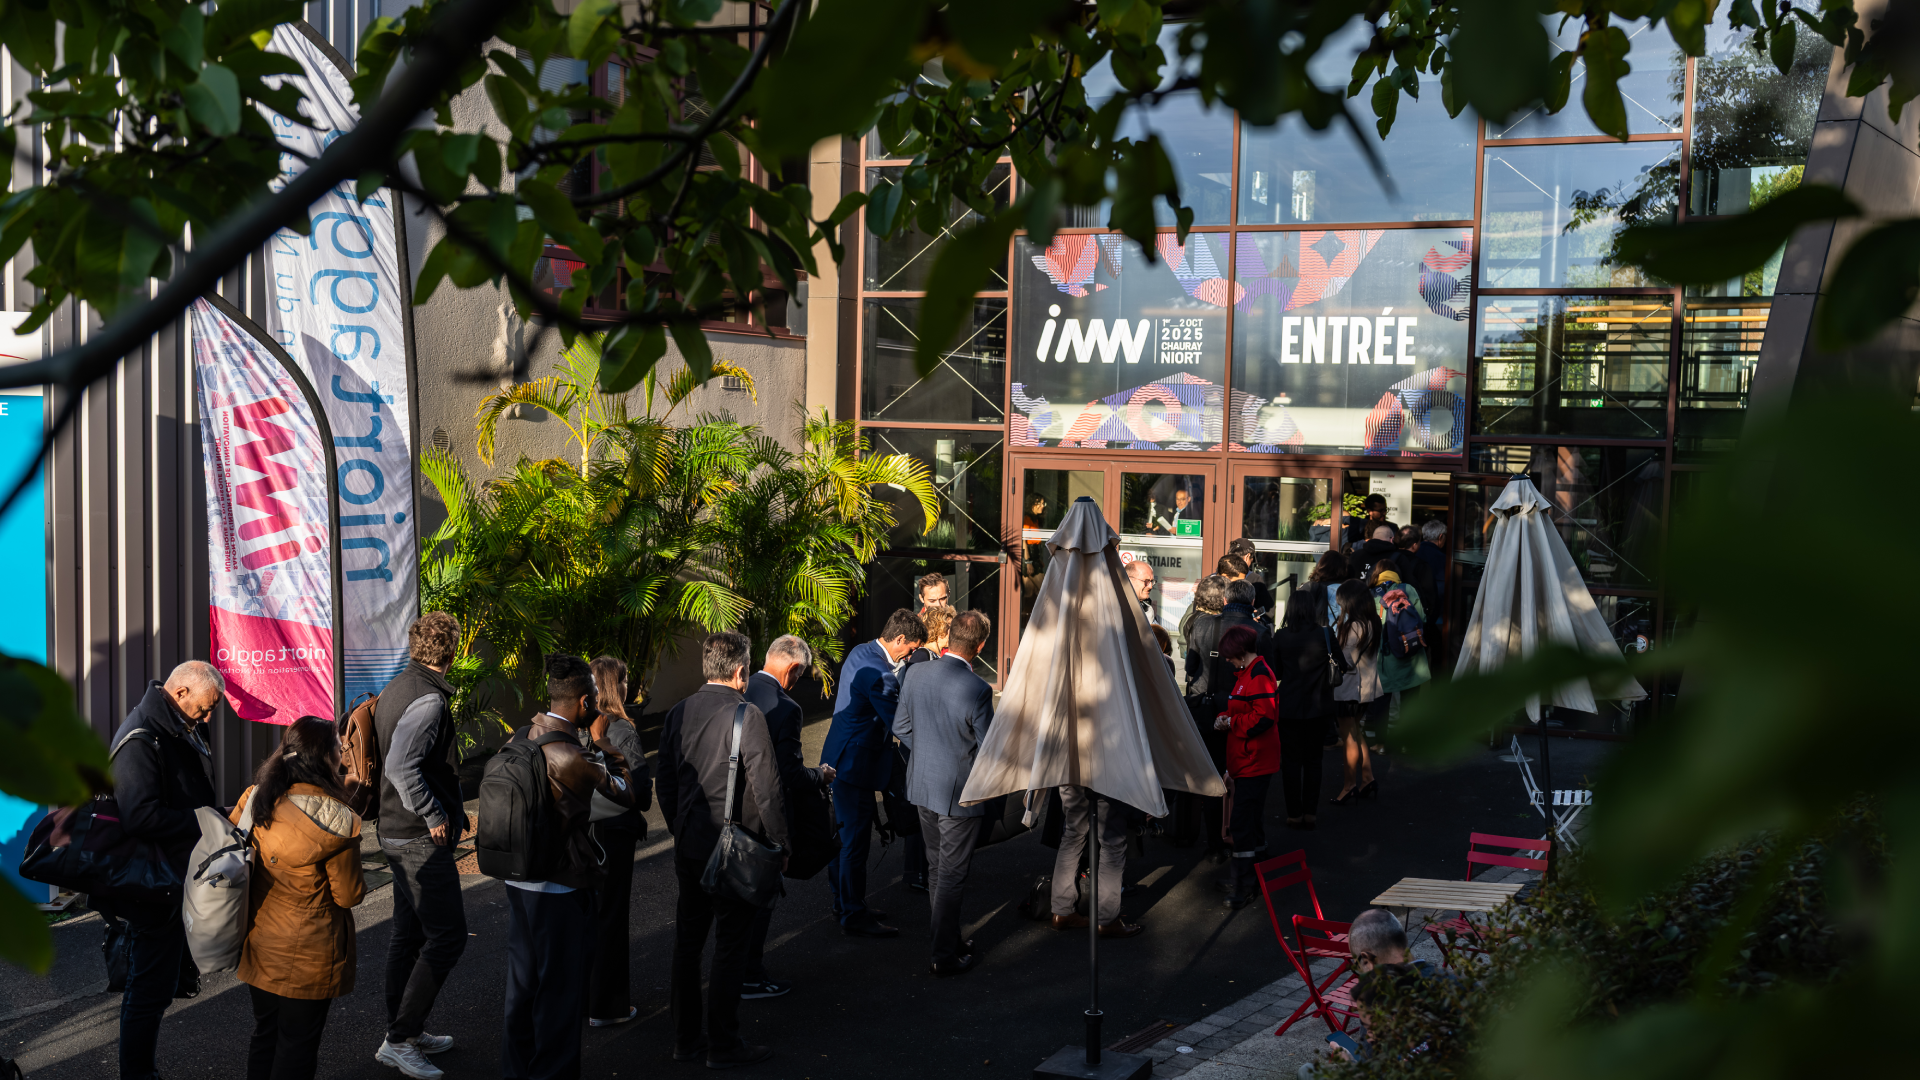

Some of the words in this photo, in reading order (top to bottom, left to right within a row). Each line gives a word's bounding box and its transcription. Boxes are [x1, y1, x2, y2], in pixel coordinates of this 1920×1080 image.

[1161, 328, 1203, 340] 2025
[1281, 307, 1418, 365] ENTRÉE
[1161, 341, 1203, 351] CHAURAY
[1161, 351, 1203, 364] NIORT
